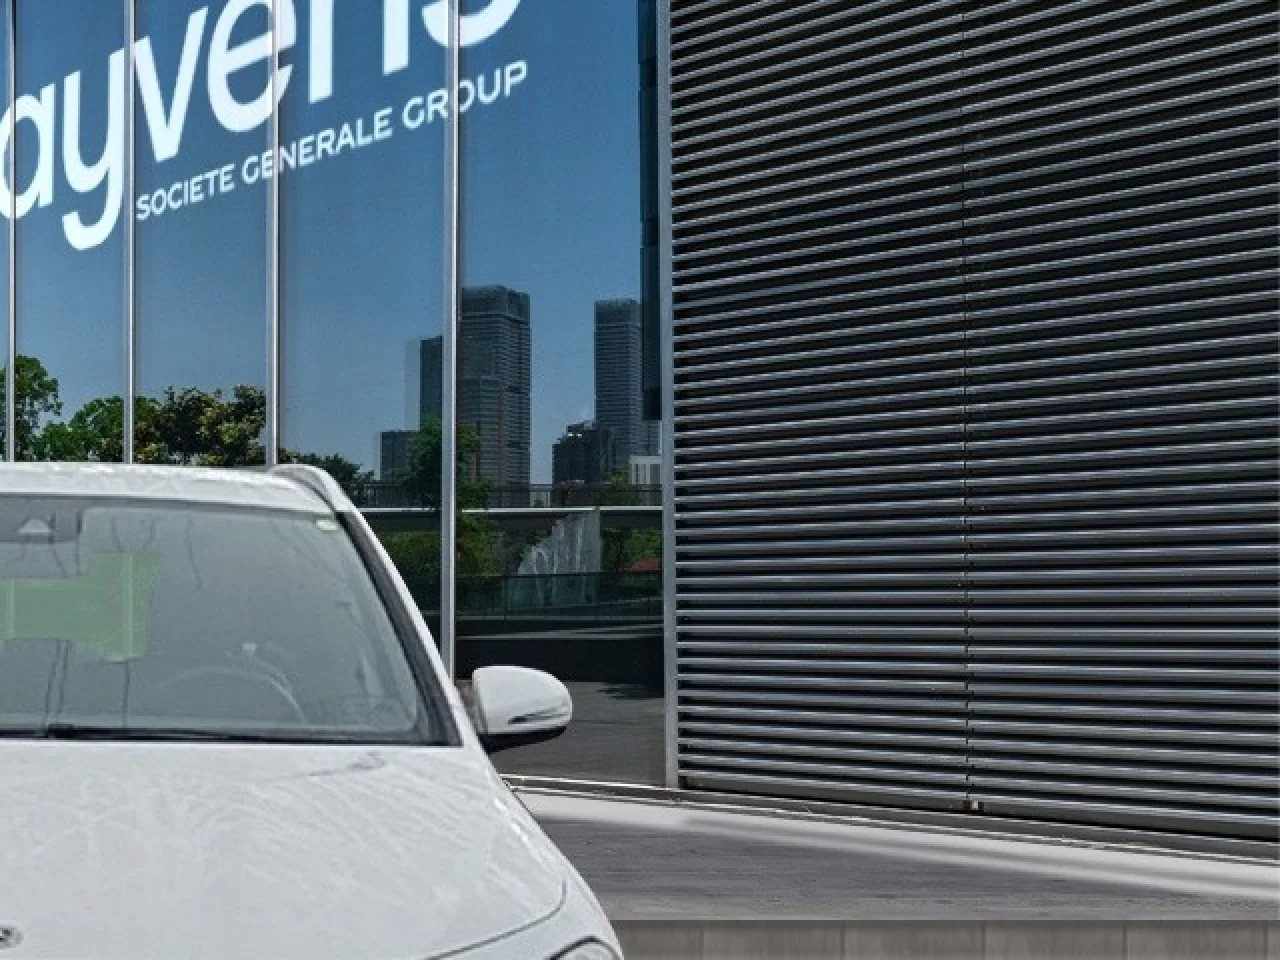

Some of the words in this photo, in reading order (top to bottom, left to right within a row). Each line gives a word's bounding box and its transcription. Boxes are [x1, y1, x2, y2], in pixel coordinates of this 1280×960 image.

[135, 163, 236, 220] SOCIETE
[241, 107, 393, 184] GENERALE
[401, 60, 528, 131] GROUP
